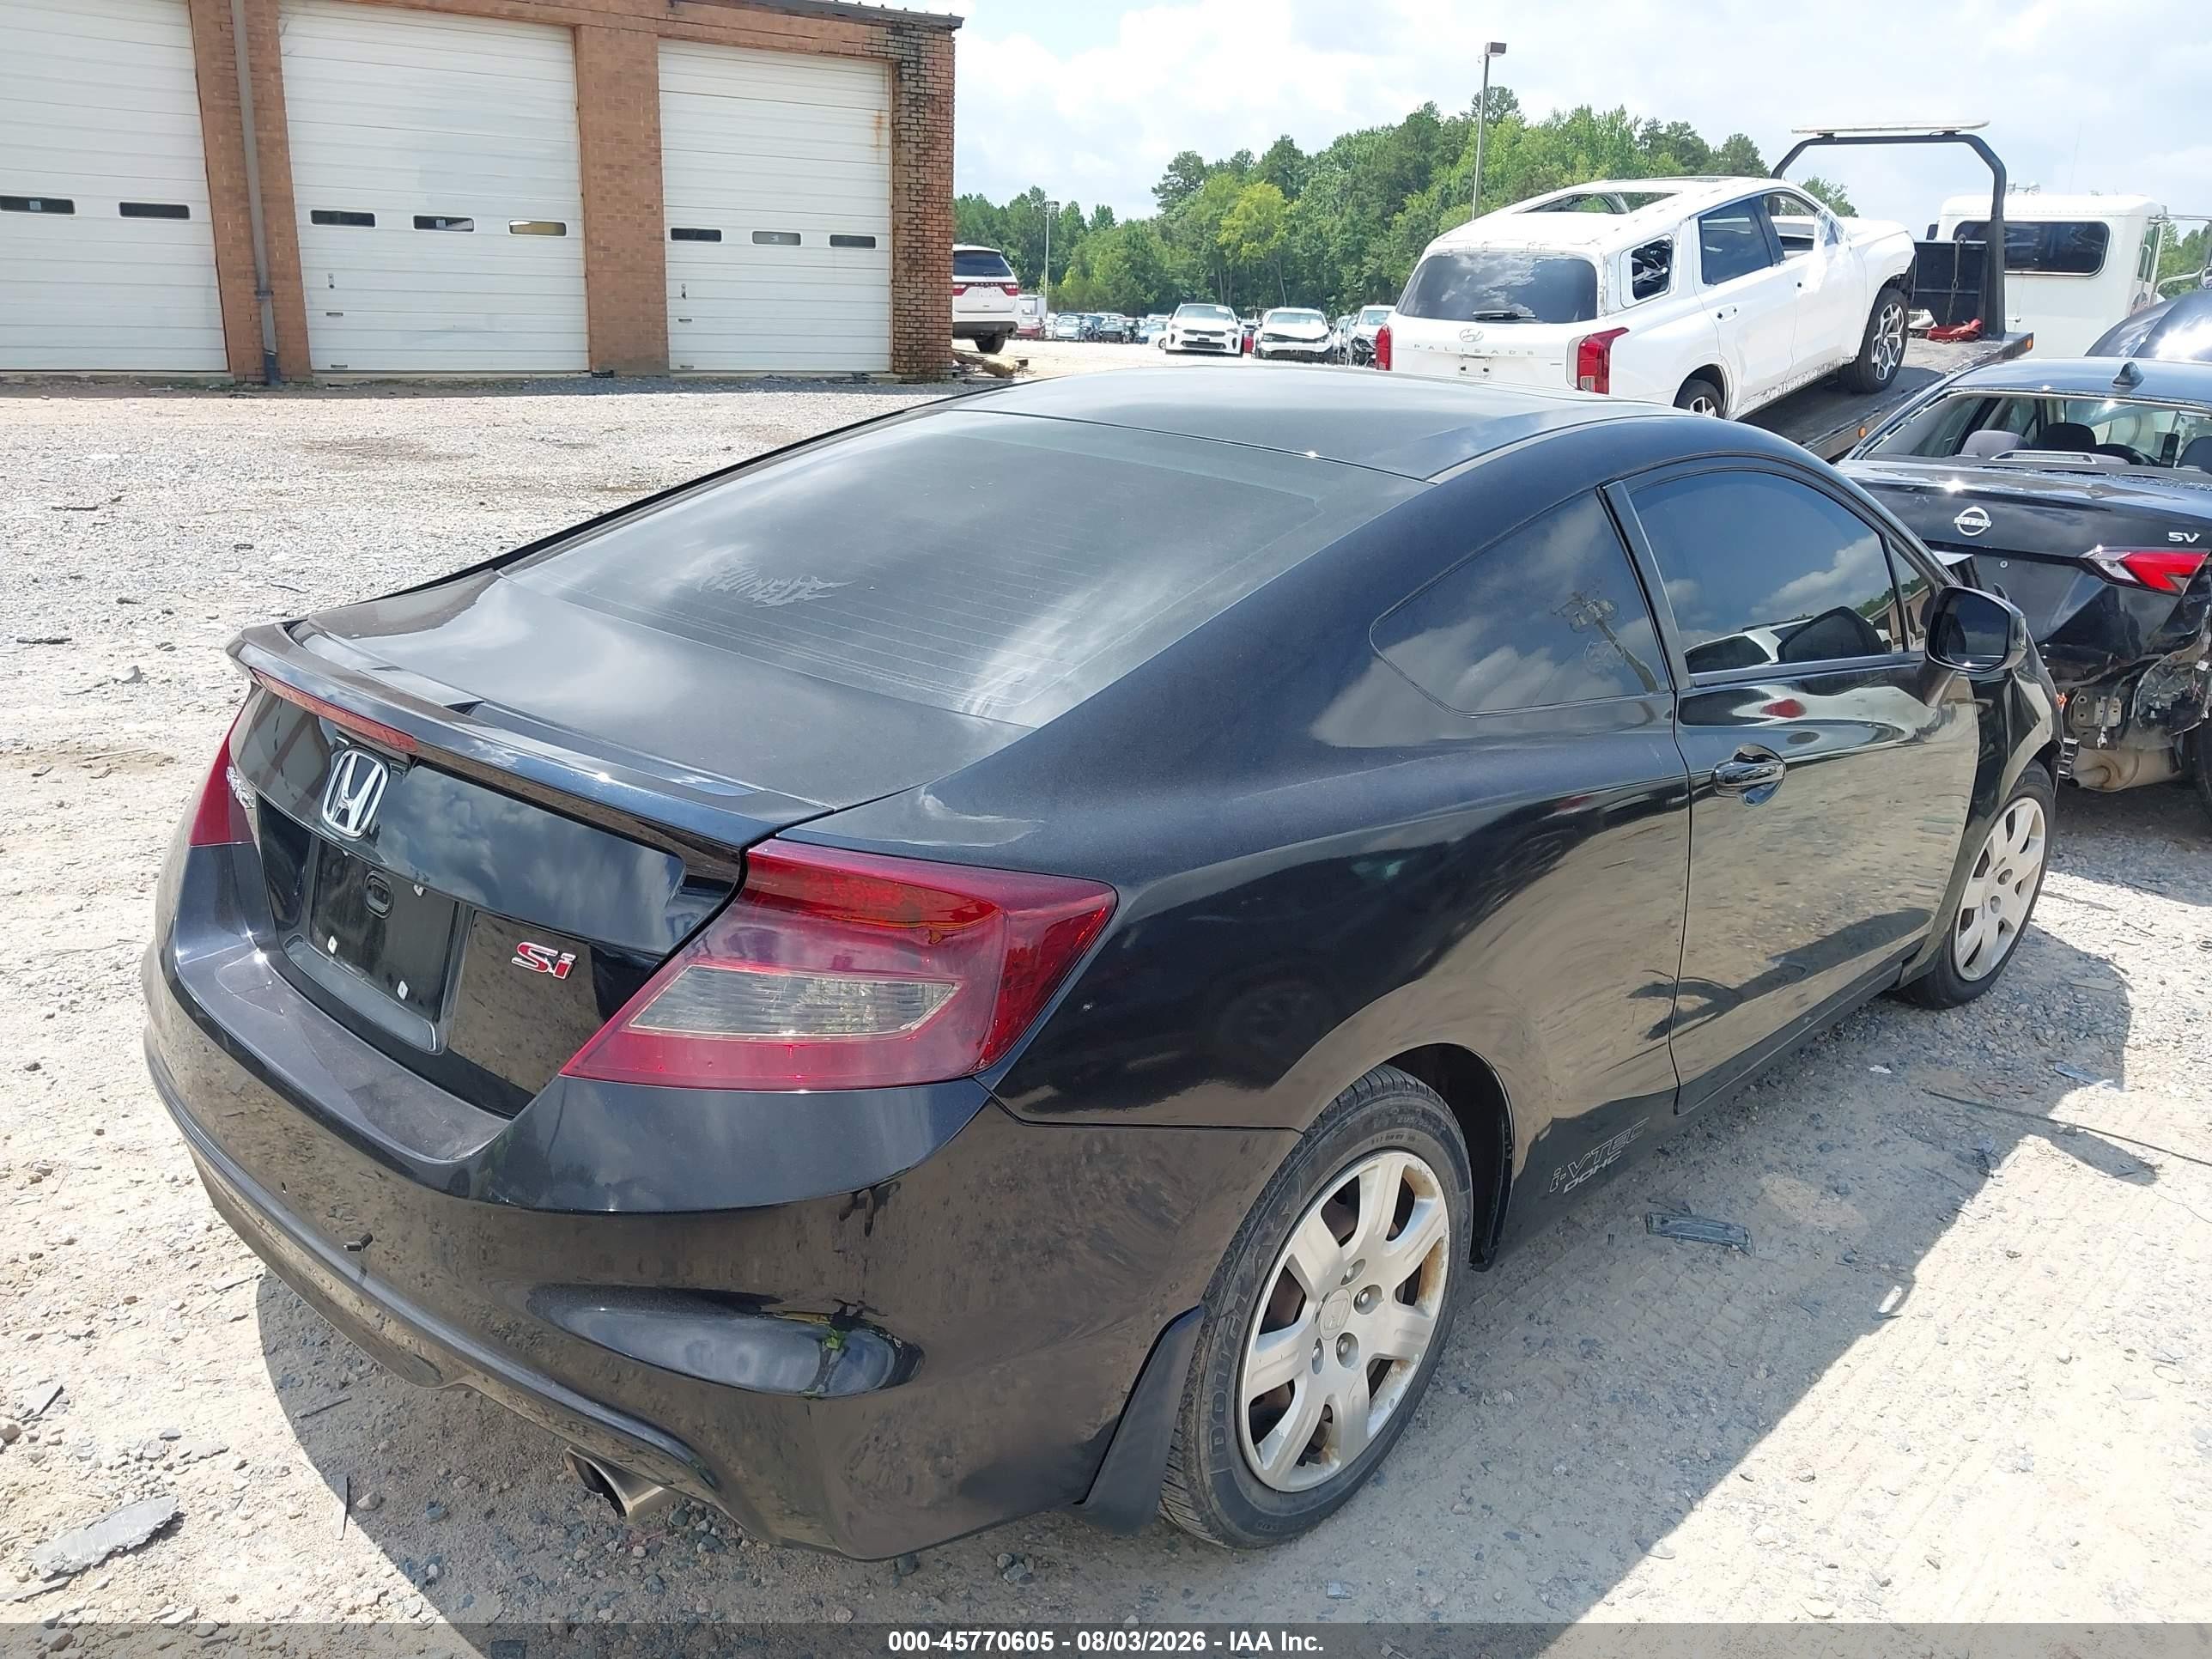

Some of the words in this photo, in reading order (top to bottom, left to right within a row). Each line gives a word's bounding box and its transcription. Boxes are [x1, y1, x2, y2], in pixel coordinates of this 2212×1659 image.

[1953, 516, 1992, 528] NISSAN
[2167, 531, 2202, 544] SV
[511, 941, 577, 980] Si
[1548, 1116, 1650, 1194] i-VTEC
[1563, 1150, 1622, 1194] DOHC
